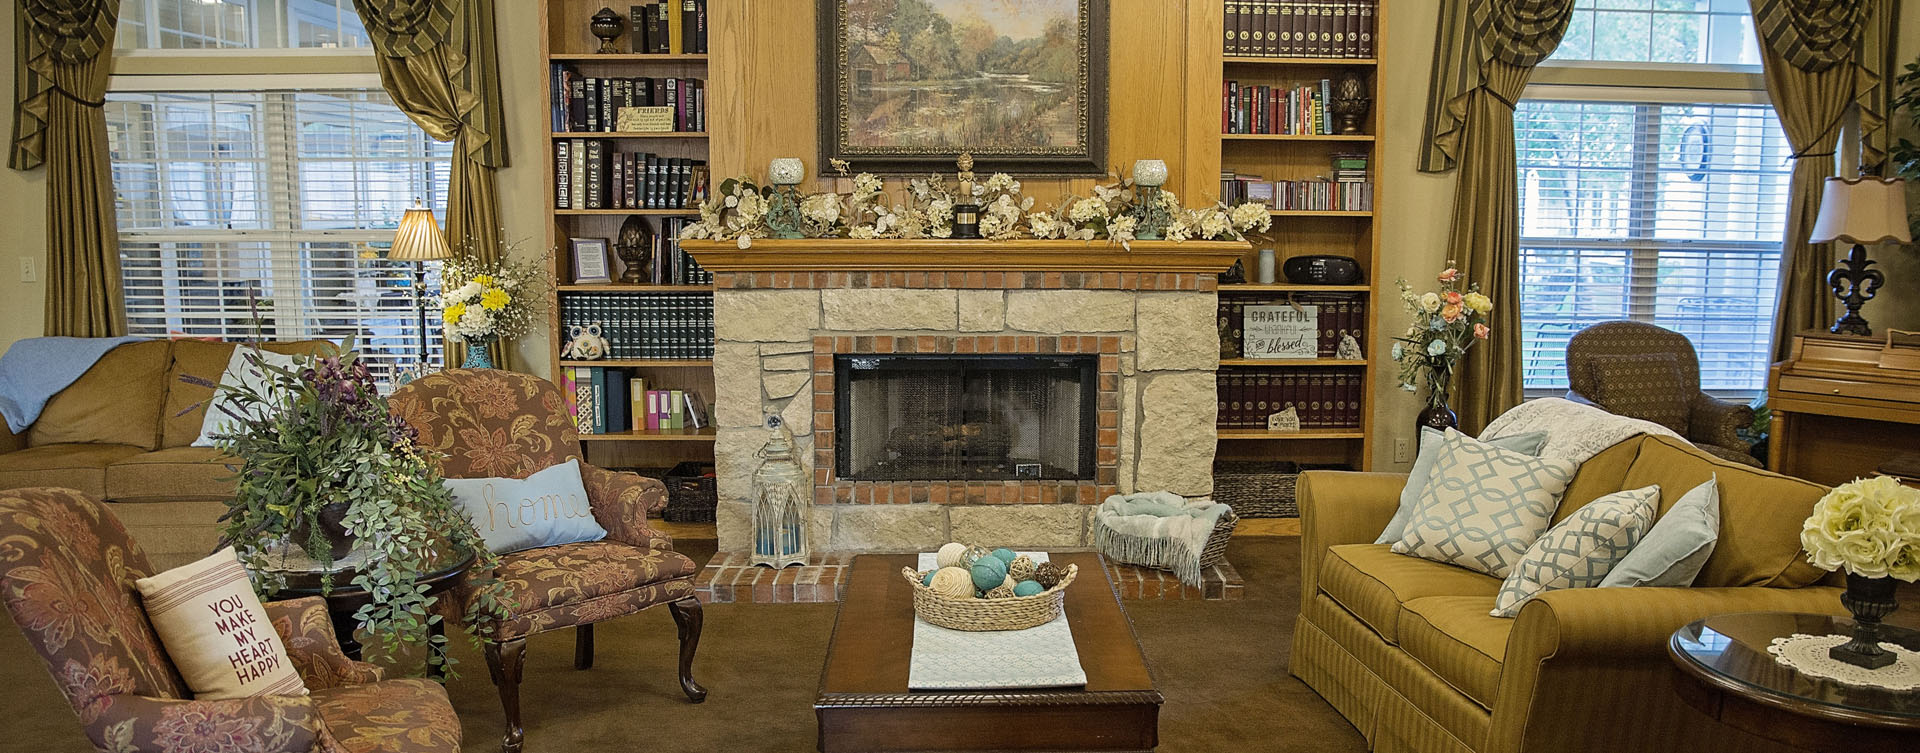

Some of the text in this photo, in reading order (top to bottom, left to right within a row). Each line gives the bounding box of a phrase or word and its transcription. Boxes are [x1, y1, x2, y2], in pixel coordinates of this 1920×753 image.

[1251, 311, 1310, 322] GRATEFUL
[1267, 334, 1303, 353] blessed
[479, 483, 593, 531] home
[208, 595, 243, 617] YOU
[215, 610, 256, 635] MAKE
[234, 627, 256, 647] MY
[229, 638, 274, 668] HEART
[236, 654, 280, 685] HAPPY
